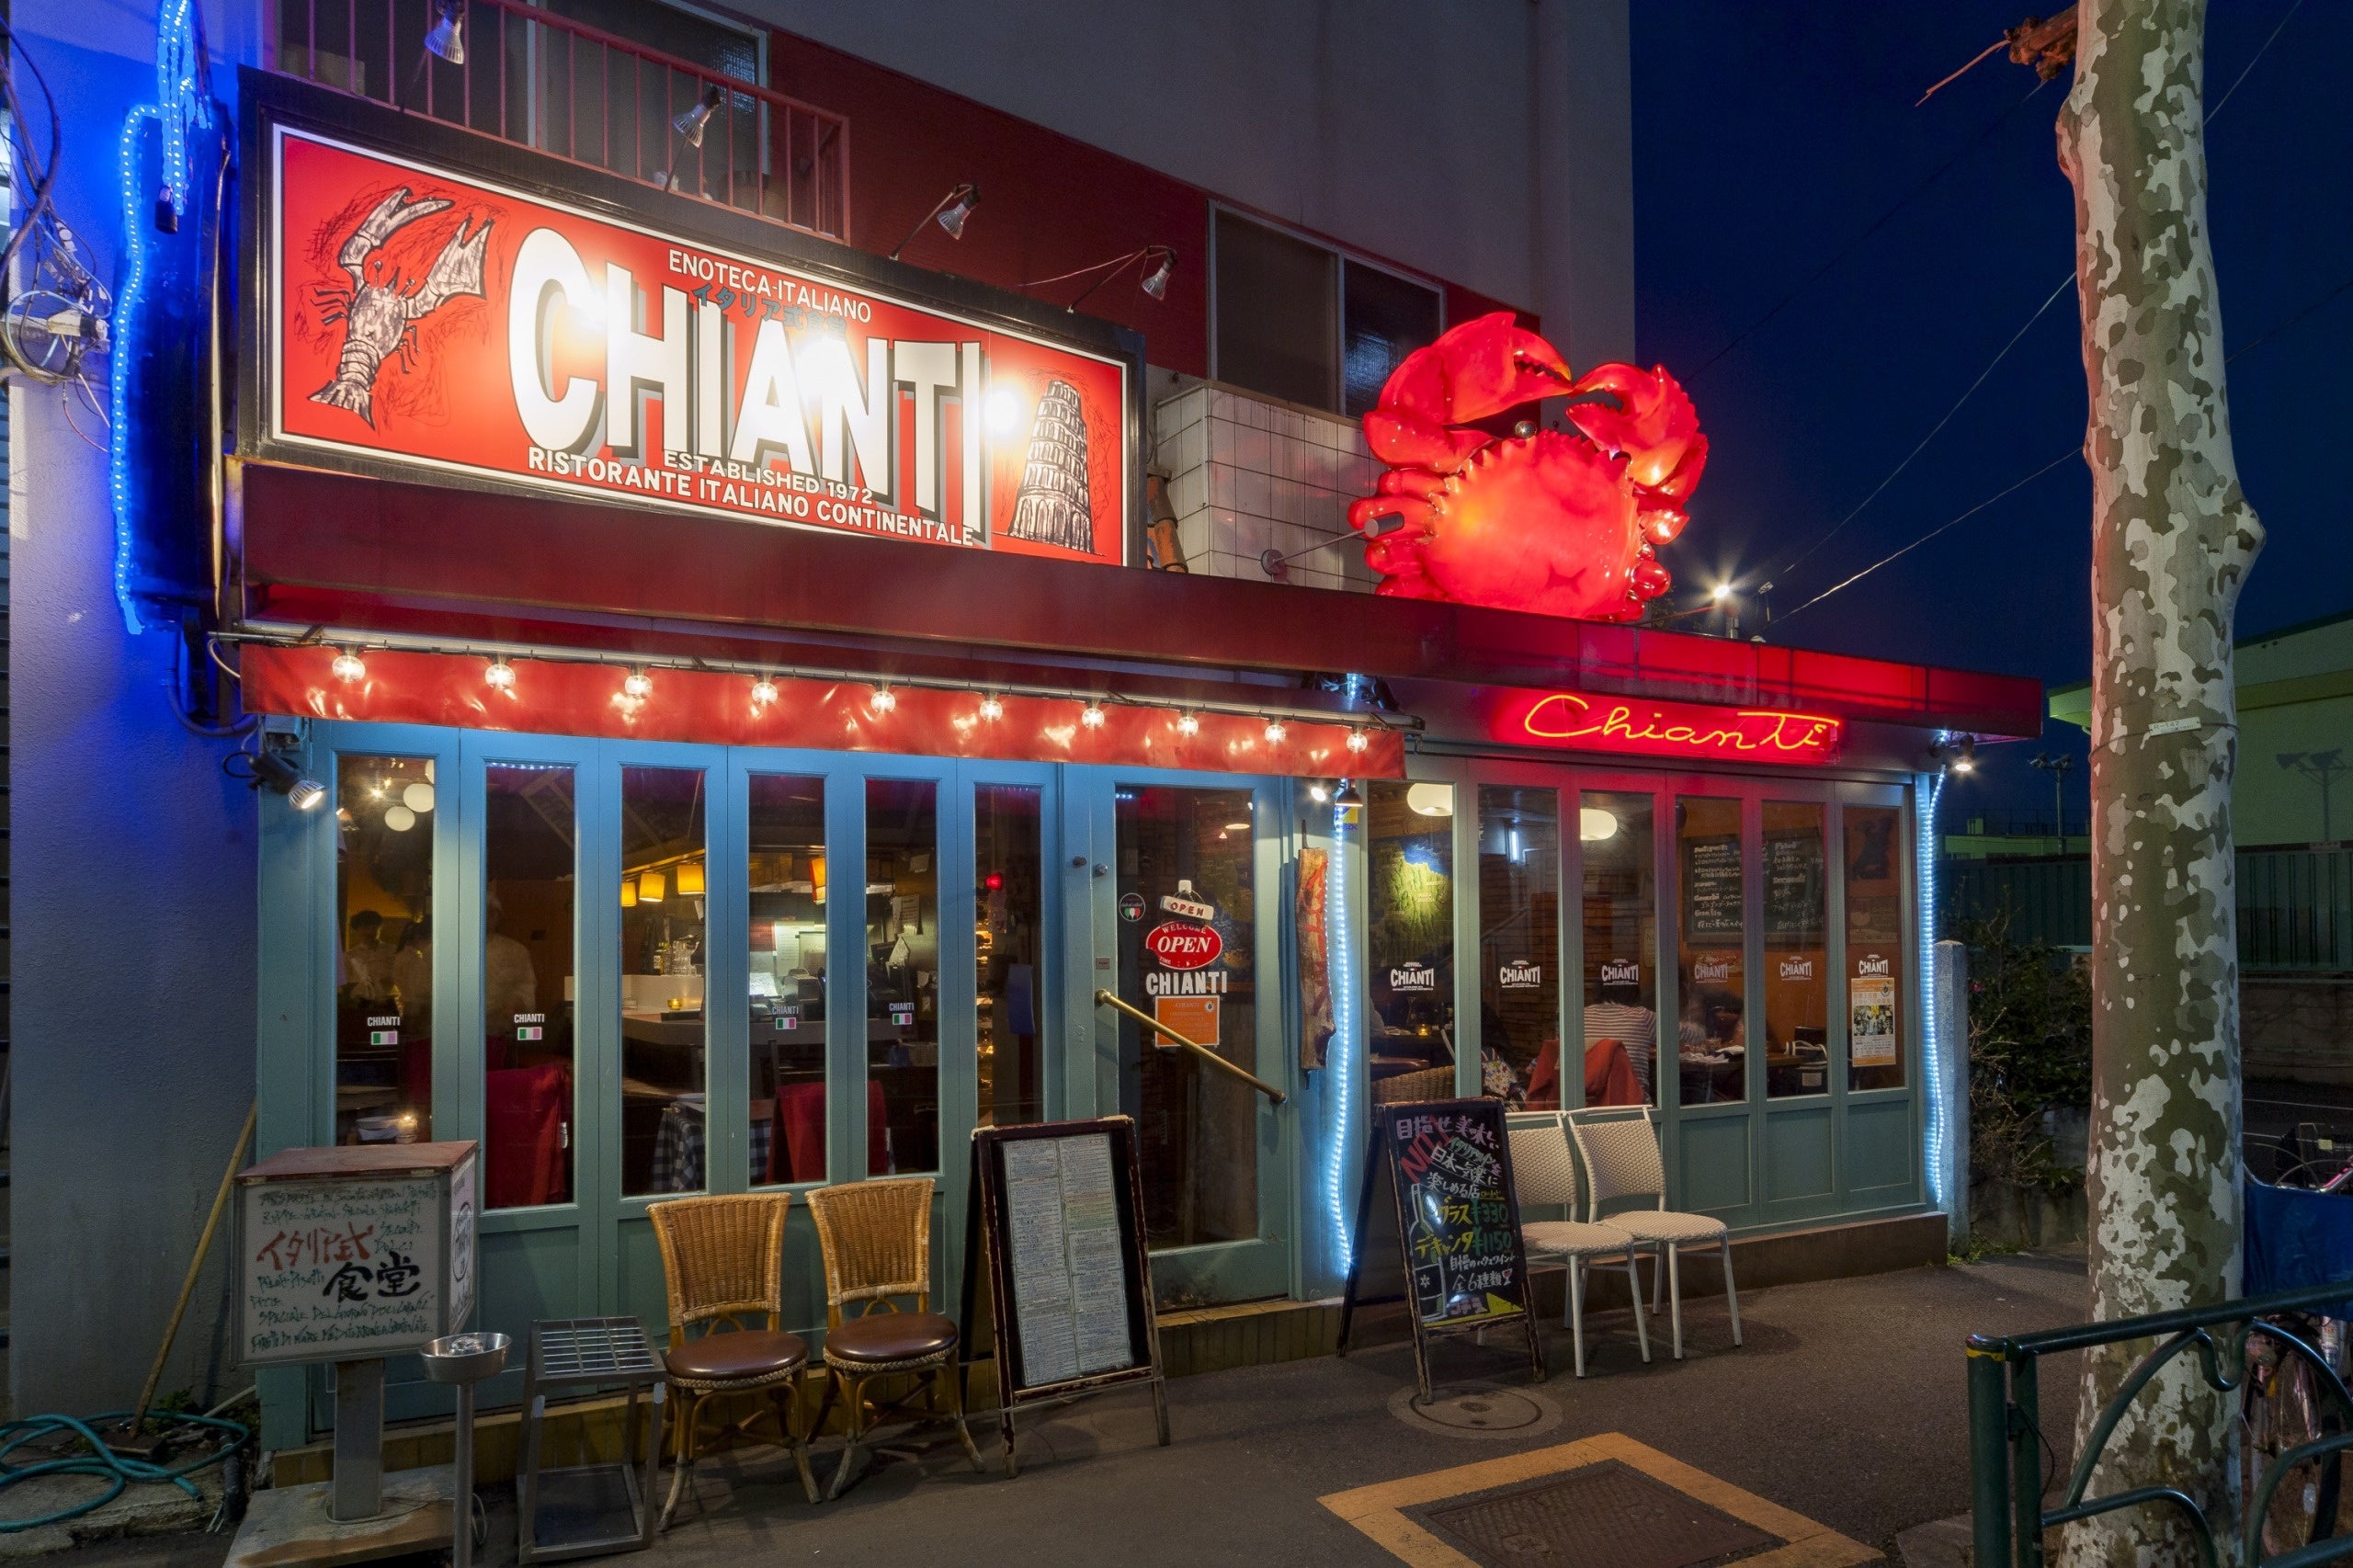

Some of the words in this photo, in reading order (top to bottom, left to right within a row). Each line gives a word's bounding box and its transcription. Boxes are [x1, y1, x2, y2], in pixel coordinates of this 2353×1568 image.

[668, 248, 872, 324] ENOTECA-ITALIANO
[508, 226, 987, 540] CHIANTI
[663, 449, 821, 494] ESTABLISHED
[826, 480, 873, 506] 1972
[528, 445, 692, 498] RISTORANTE
[699, 477, 810, 518] ITALIANO
[816, 499, 974, 547] CONTINENTALE
[1524, 694, 1840, 750] Chianti
[1170, 902, 1205, 916] OPEN
[1157, 936, 1212, 953] OPEN
[1499, 965, 1540, 984] CHIANTI
[1601, 964, 1640, 982] CHIANTI
[1694, 962, 1729, 979] CHIANTI
[1779, 960, 1813, 977] CHIANTI
[1859, 959, 1889, 975] CHIANTI
[1145, 971, 1228, 995] CHIANTI
[1390, 968, 1435, 987] CHIANTI
[771, 1005, 800, 1016] CHIANTI
[889, 1002, 915, 1012] CHIANTI
[367, 1016, 402, 1028] CHIANTI
[514, 1013, 545, 1024] CHIANTI
[1427, 1171, 1481, 1199] 楽しめる店
[1438, 1196, 1473, 1227] グラス
[256, 1221, 374, 1271] イタリア式
[1415, 1231, 1474, 1259] デキャンタ
[322, 1250, 421, 1303] 食堂
